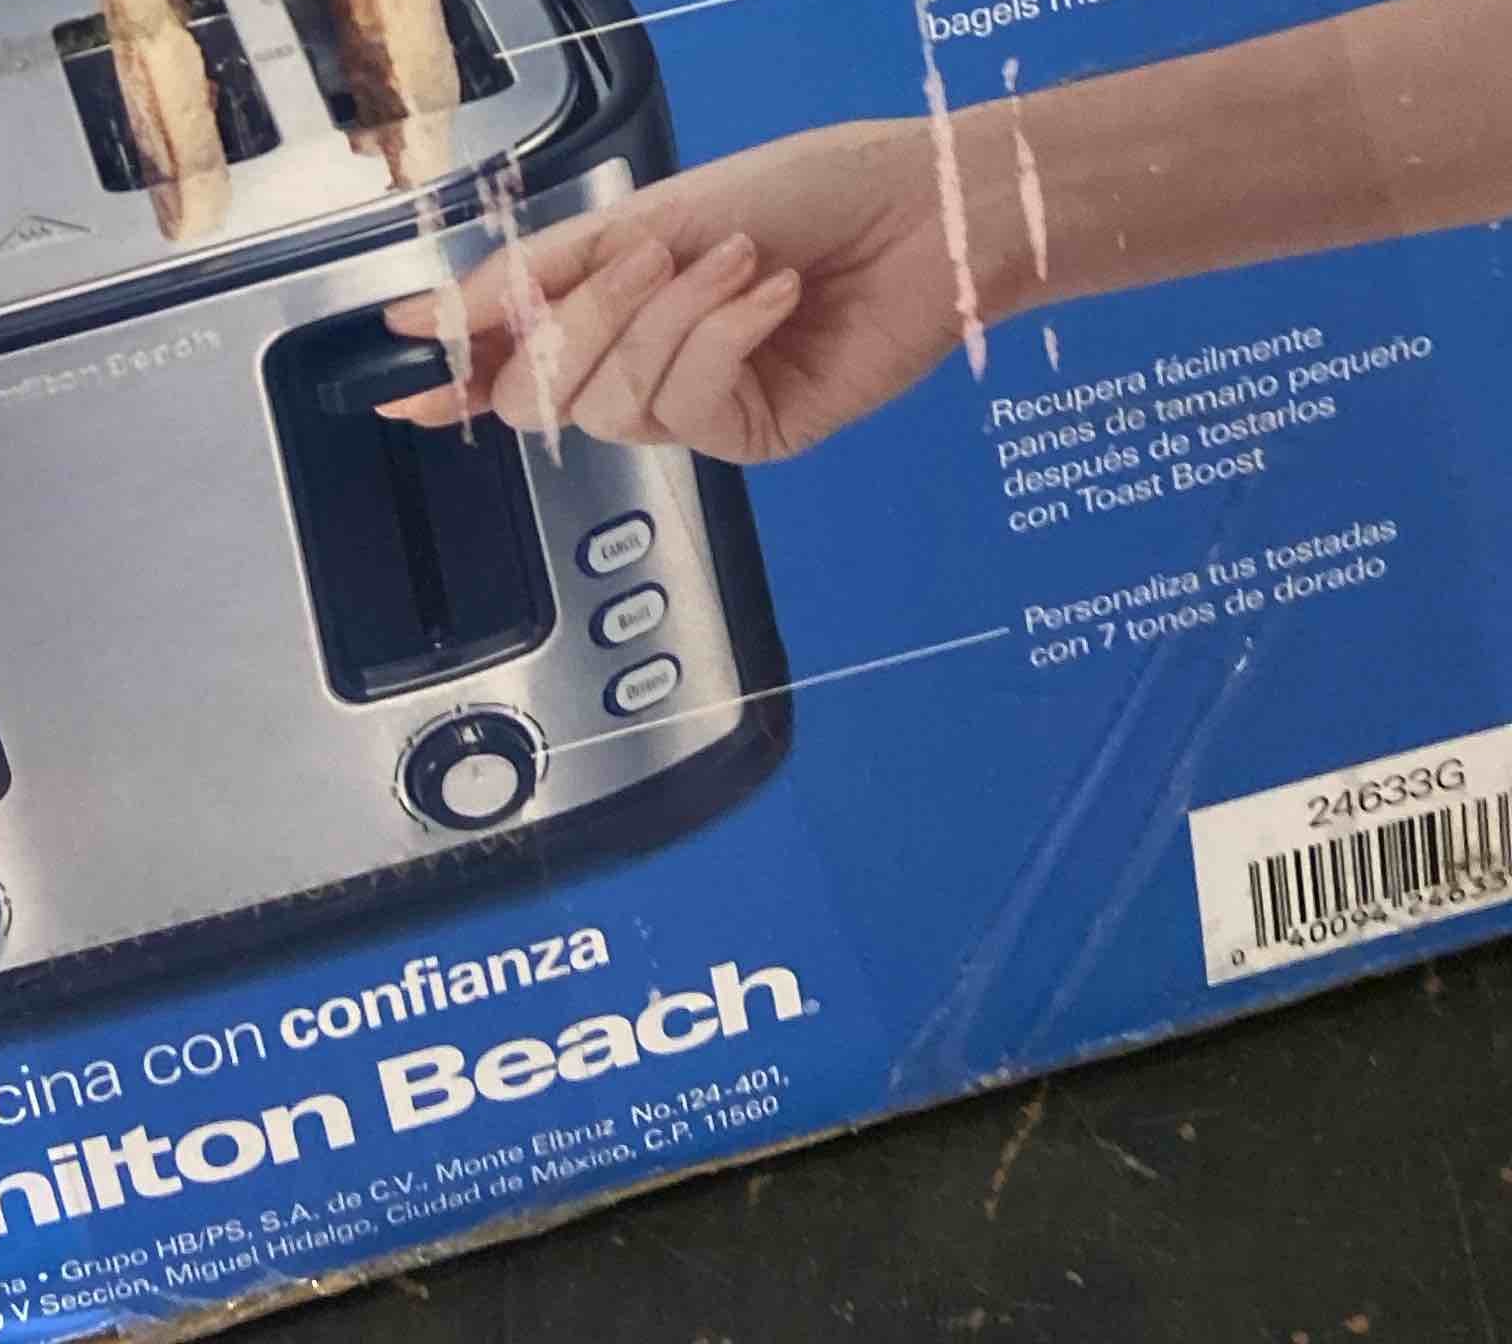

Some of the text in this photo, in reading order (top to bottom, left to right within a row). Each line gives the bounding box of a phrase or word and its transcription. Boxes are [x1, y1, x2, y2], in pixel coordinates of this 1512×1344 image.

[991, 325, 1324, 428] Recupera fácilmente
[998, 333, 1433, 467] panes de tamaño pequeño
[1003, 394, 1337, 498] después de tostarlos
[1009, 446, 1267, 534] con Toast Boost
[1023, 517, 1399, 634] Personaliza tus tostadas
[1029, 555, 1386, 669] con 7 tonos de dorado
[1307, 758, 1465, 828] 24633G
[143, 1022, 268, 1085] con
[279, 927, 610, 1050] confianza
[377, 961, 804, 1133] Beach
[11, 1300, 30, 1322] V
[40, 1278, 159, 1316] Sección,
[164, 1245, 258, 1287] Miguel
[266, 1217, 379, 1260] Hidalgo,
[386, 1185, 481, 1226] Ciudad
[488, 1174, 524, 1197] de
[61, 1247, 149, 1282] Grupo
[155, 1218, 253, 1260] HB/PS,
[260, 1201, 320, 1233] S.A.
[327, 1191, 362, 1214] de
[435, 1145, 525, 1185] Monte
[532, 1119, 615, 1157] Elbruz
